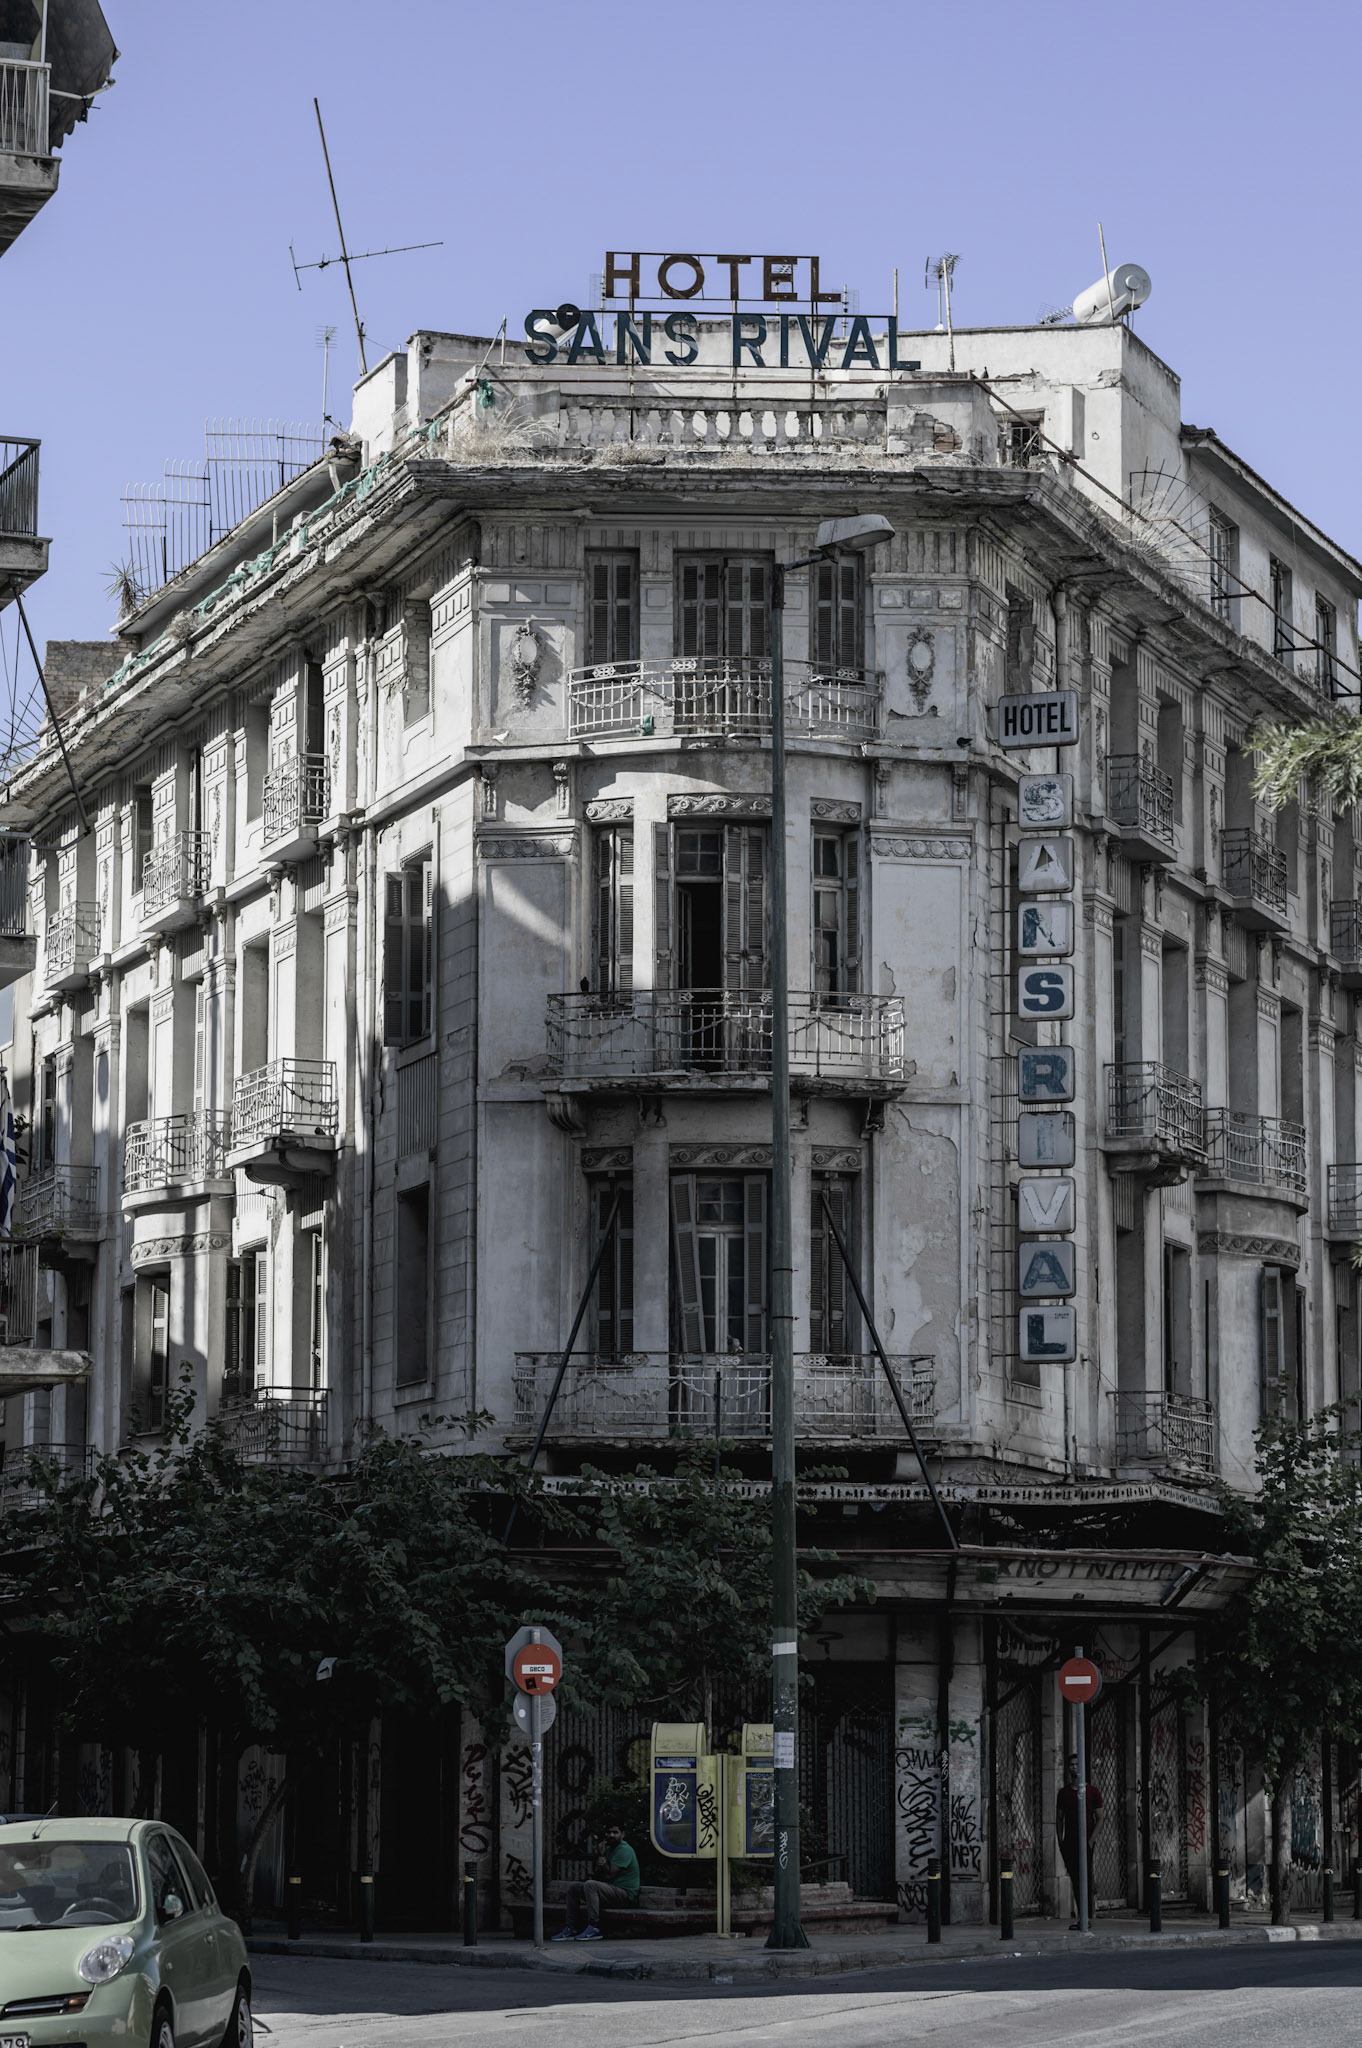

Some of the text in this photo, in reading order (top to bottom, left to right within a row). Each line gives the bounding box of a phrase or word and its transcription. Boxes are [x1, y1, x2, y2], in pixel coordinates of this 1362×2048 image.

[605, 251, 842, 302] HOTEL
[523, 308, 921, 371] SANS RIVAL
[1003, 700, 1071, 737] HOTEL
